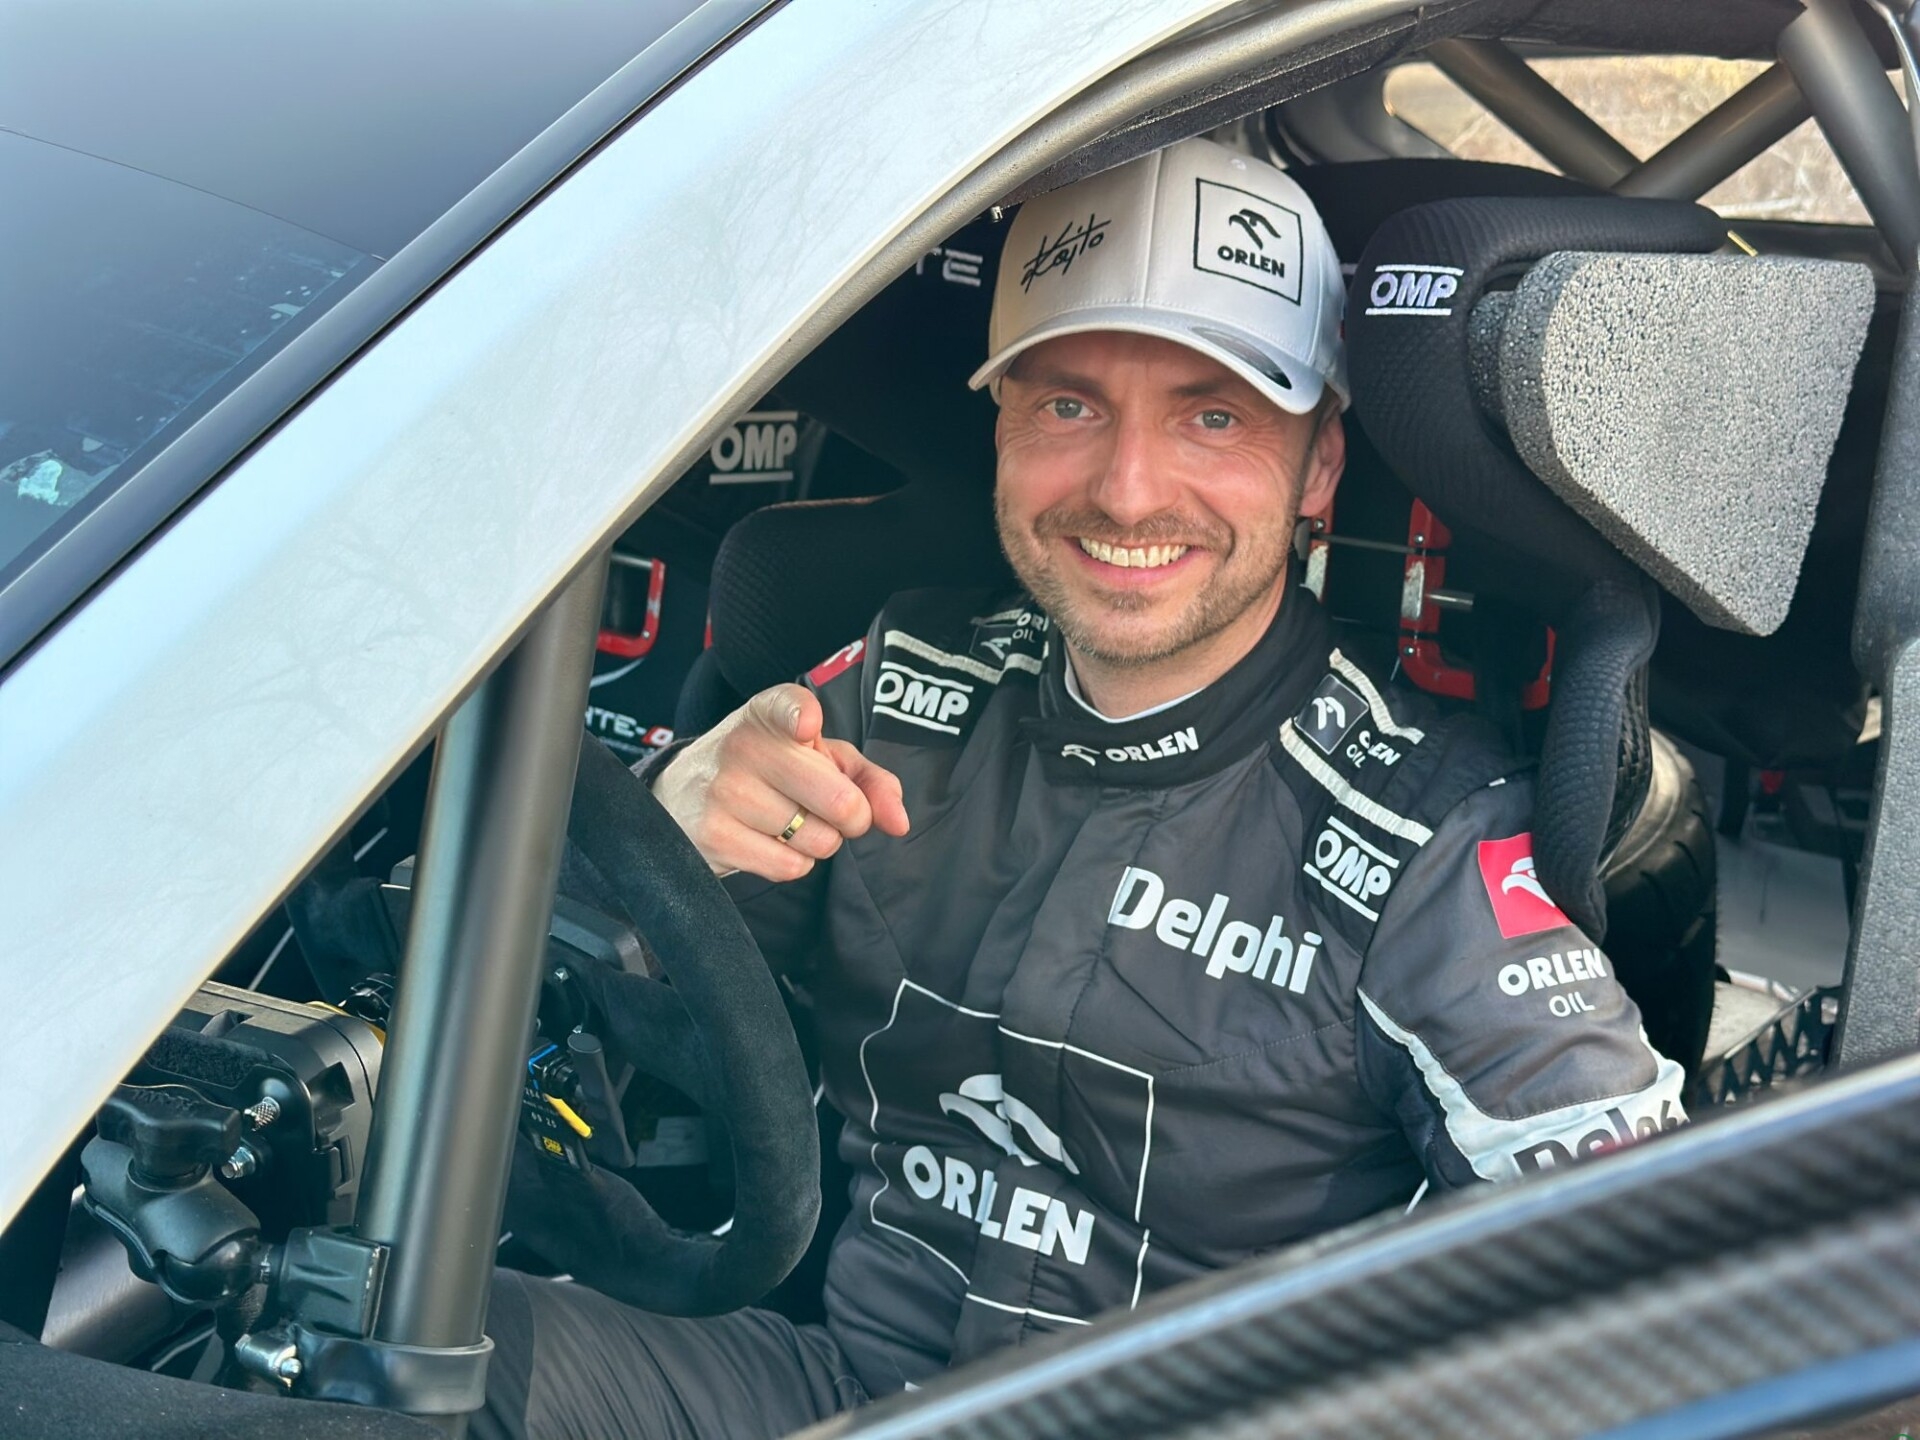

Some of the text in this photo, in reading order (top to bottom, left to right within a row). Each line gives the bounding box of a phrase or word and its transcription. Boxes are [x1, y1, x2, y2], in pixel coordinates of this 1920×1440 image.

[1217, 245, 1285, 278] ORLEN
[1370, 272, 1458, 307] OMP
[710, 424, 797, 471] OMP
[1012, 629, 1036, 643] OIL
[875, 671, 969, 722] OMP
[1105, 727, 1199, 762] ORLEN
[1346, 744, 1366, 768] OIL
[1359, 730, 1401, 766] OEN
[1315, 829, 1391, 902] OMP
[1107, 866, 1322, 994] Delphi
[1497, 948, 1607, 996] ORLEN
[1549, 991, 1595, 1017] OIL
[902, 1145, 1095, 1265] ORLEN
